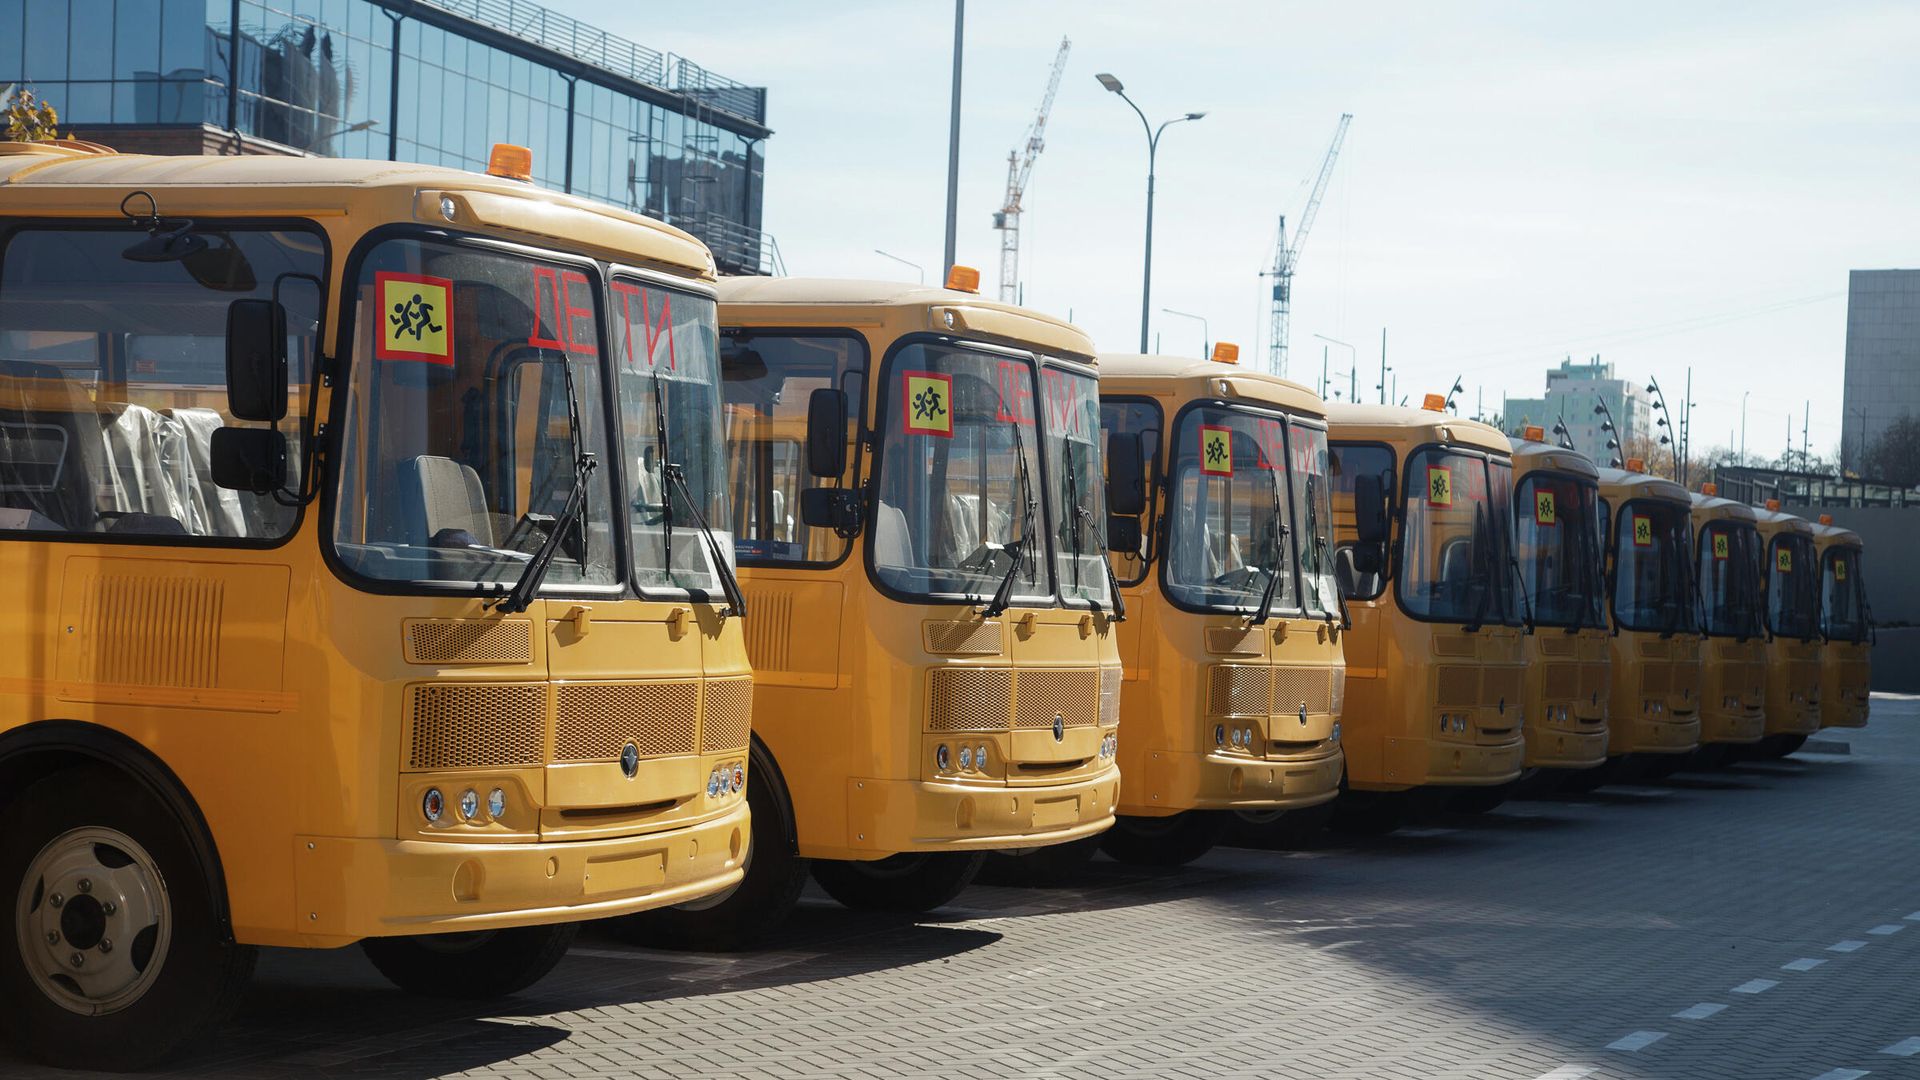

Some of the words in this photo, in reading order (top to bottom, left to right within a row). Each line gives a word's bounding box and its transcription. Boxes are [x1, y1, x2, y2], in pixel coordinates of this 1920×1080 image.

[528, 266, 675, 371] ДЕТИ
[995, 360, 1079, 433] ДЕТИ
[1256, 418, 1317, 480] ДЕТИ
